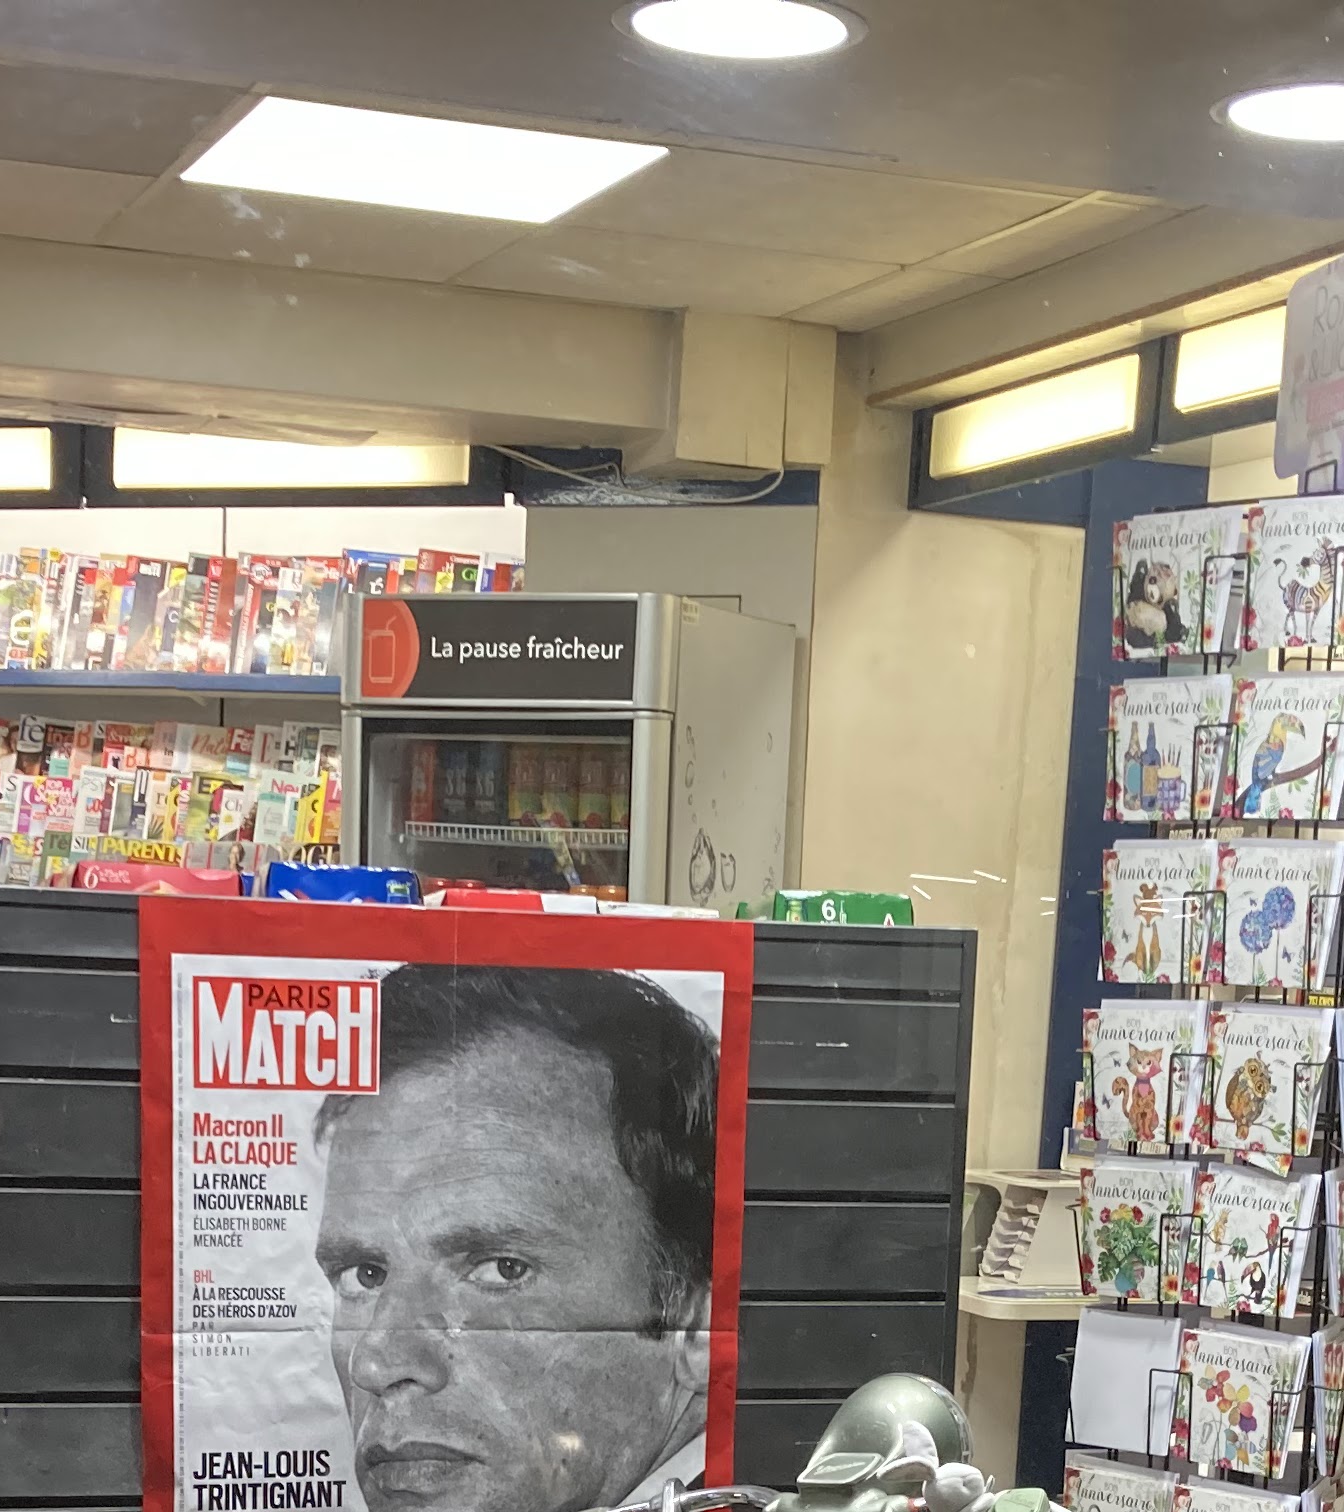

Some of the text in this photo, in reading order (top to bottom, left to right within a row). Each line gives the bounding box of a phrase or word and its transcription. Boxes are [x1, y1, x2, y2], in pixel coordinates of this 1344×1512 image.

[431, 635, 624, 664] La pause fraîcheur
[822, 899, 836, 920] 6
[248, 984, 332, 1008] PARIS
[197, 981, 375, 1088] MATCH
[192, 1113, 284, 1138] Macron II
[192, 1141, 298, 1168] LA CLAQUE
[192, 1173, 267, 1191] LA FRANCE
[192, 1194, 309, 1212] INGOUVERNABLE
[192, 1216, 287, 1232] ÉLISABETH BORNE
[192, 1231, 244, 1248] MENACÉE
[193, 1269, 215, 1284] BHL
[192, 1284, 286, 1301] À LA RESCOUSSE
[192, 1302, 297, 1319] DES HÉROS D'AZOV
[192, 1321, 215, 1331] PAR
[192, 1334, 233, 1344] SIMON
[192, 1347, 250, 1357] LIBERATI
[193, 1449, 331, 1480] JEAN-LOUIS
[193, 1480, 347, 1511] TRINTIGNANT
